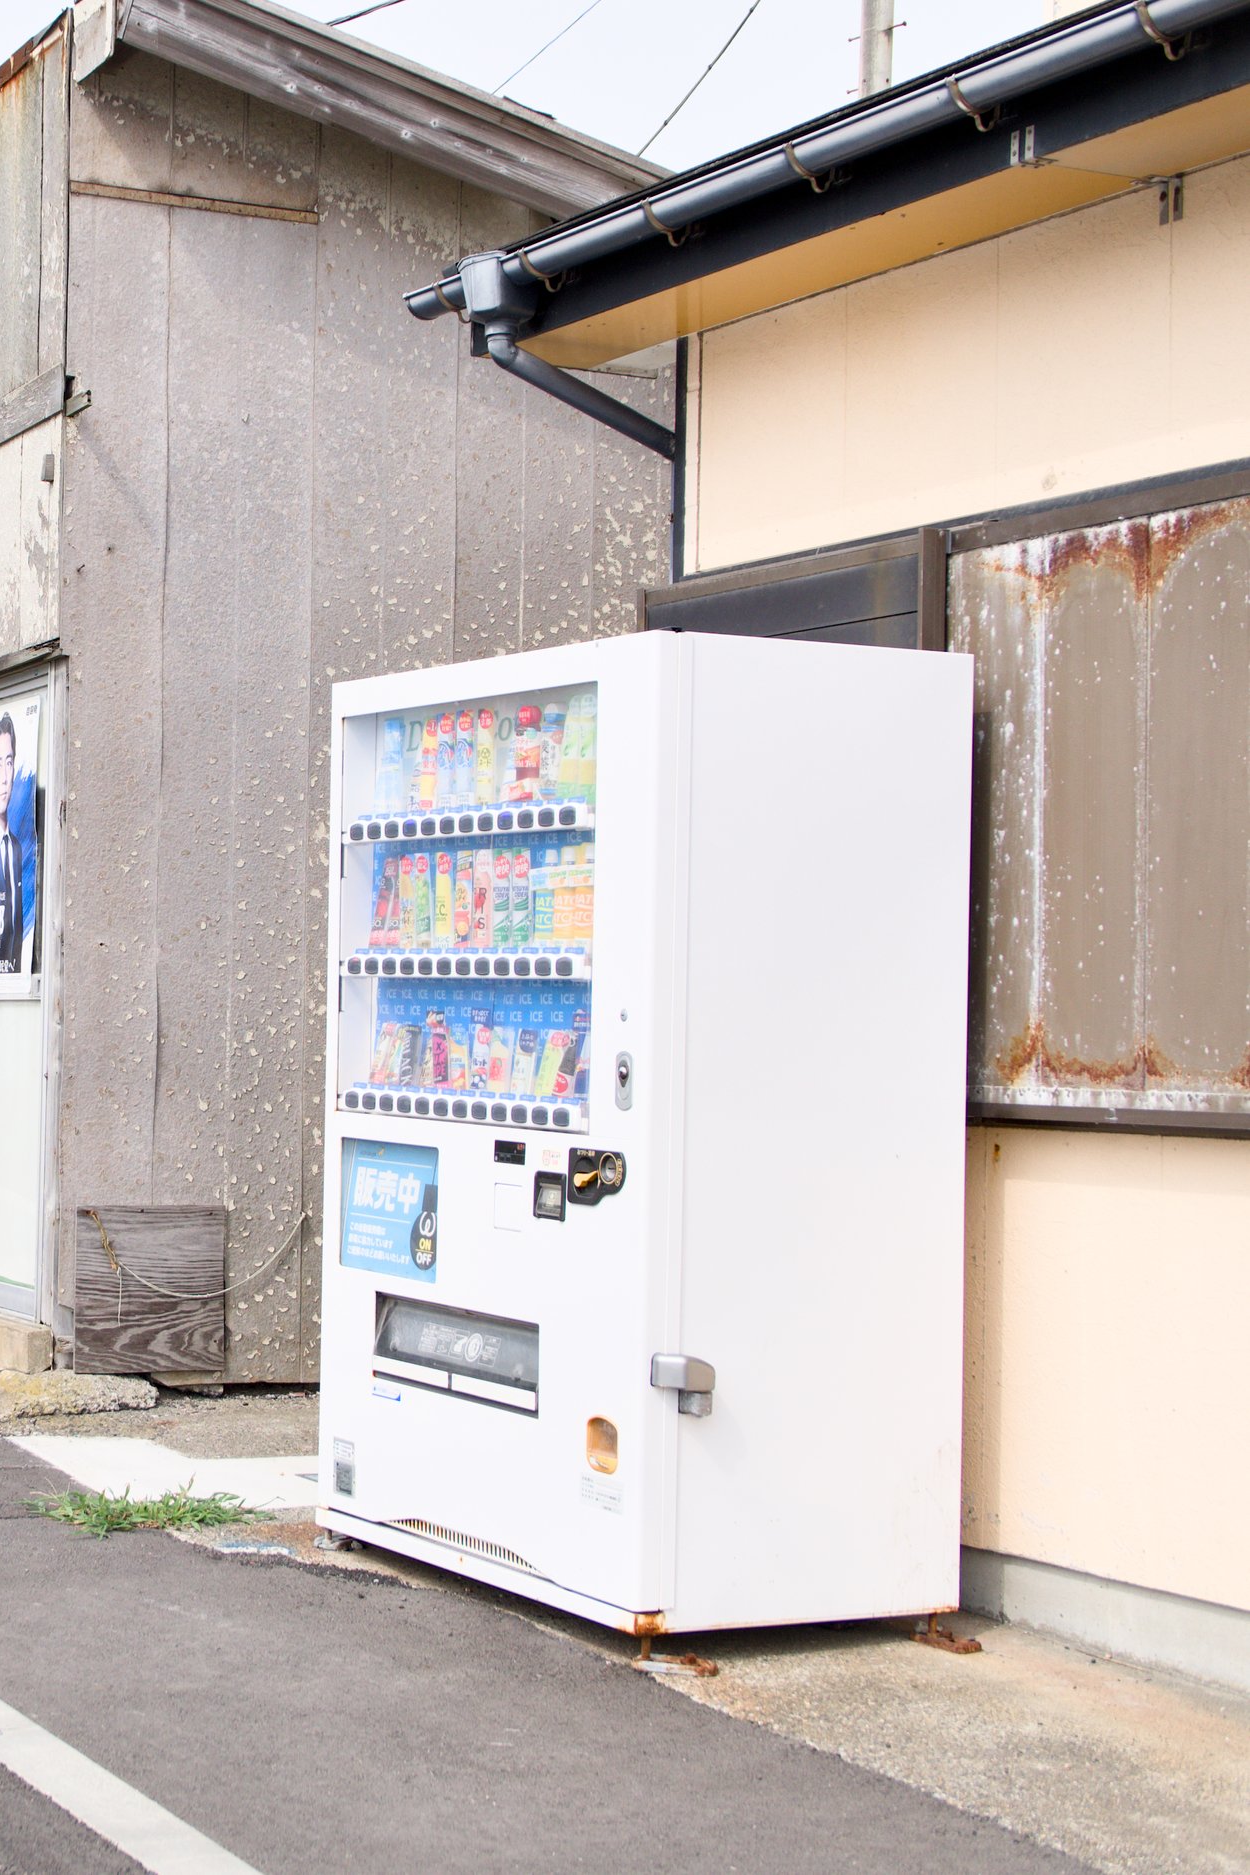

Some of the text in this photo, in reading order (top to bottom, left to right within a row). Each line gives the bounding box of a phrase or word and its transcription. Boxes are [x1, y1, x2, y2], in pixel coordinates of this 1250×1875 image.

[519, 994, 532, 1004] ICE
[540, 994, 553, 1004] ICE
[561, 994, 575, 1004] ICE
[394, 1005, 405, 1015] ICE
[410, 1005, 421, 1015] ICE
[445, 1006, 456, 1017] ICE
[460, 1006, 472, 1017] ICE
[494, 1011, 505, 1022] ICE
[510, 1011, 522, 1022] ICE
[530, 1011, 543, 1022] ICE
[551, 1011, 564, 1022] ICE
[353, 1166, 421, 1214] 販売中
[418, 1238, 432, 1250] ON
[416, 1252, 432, 1266] OFF
